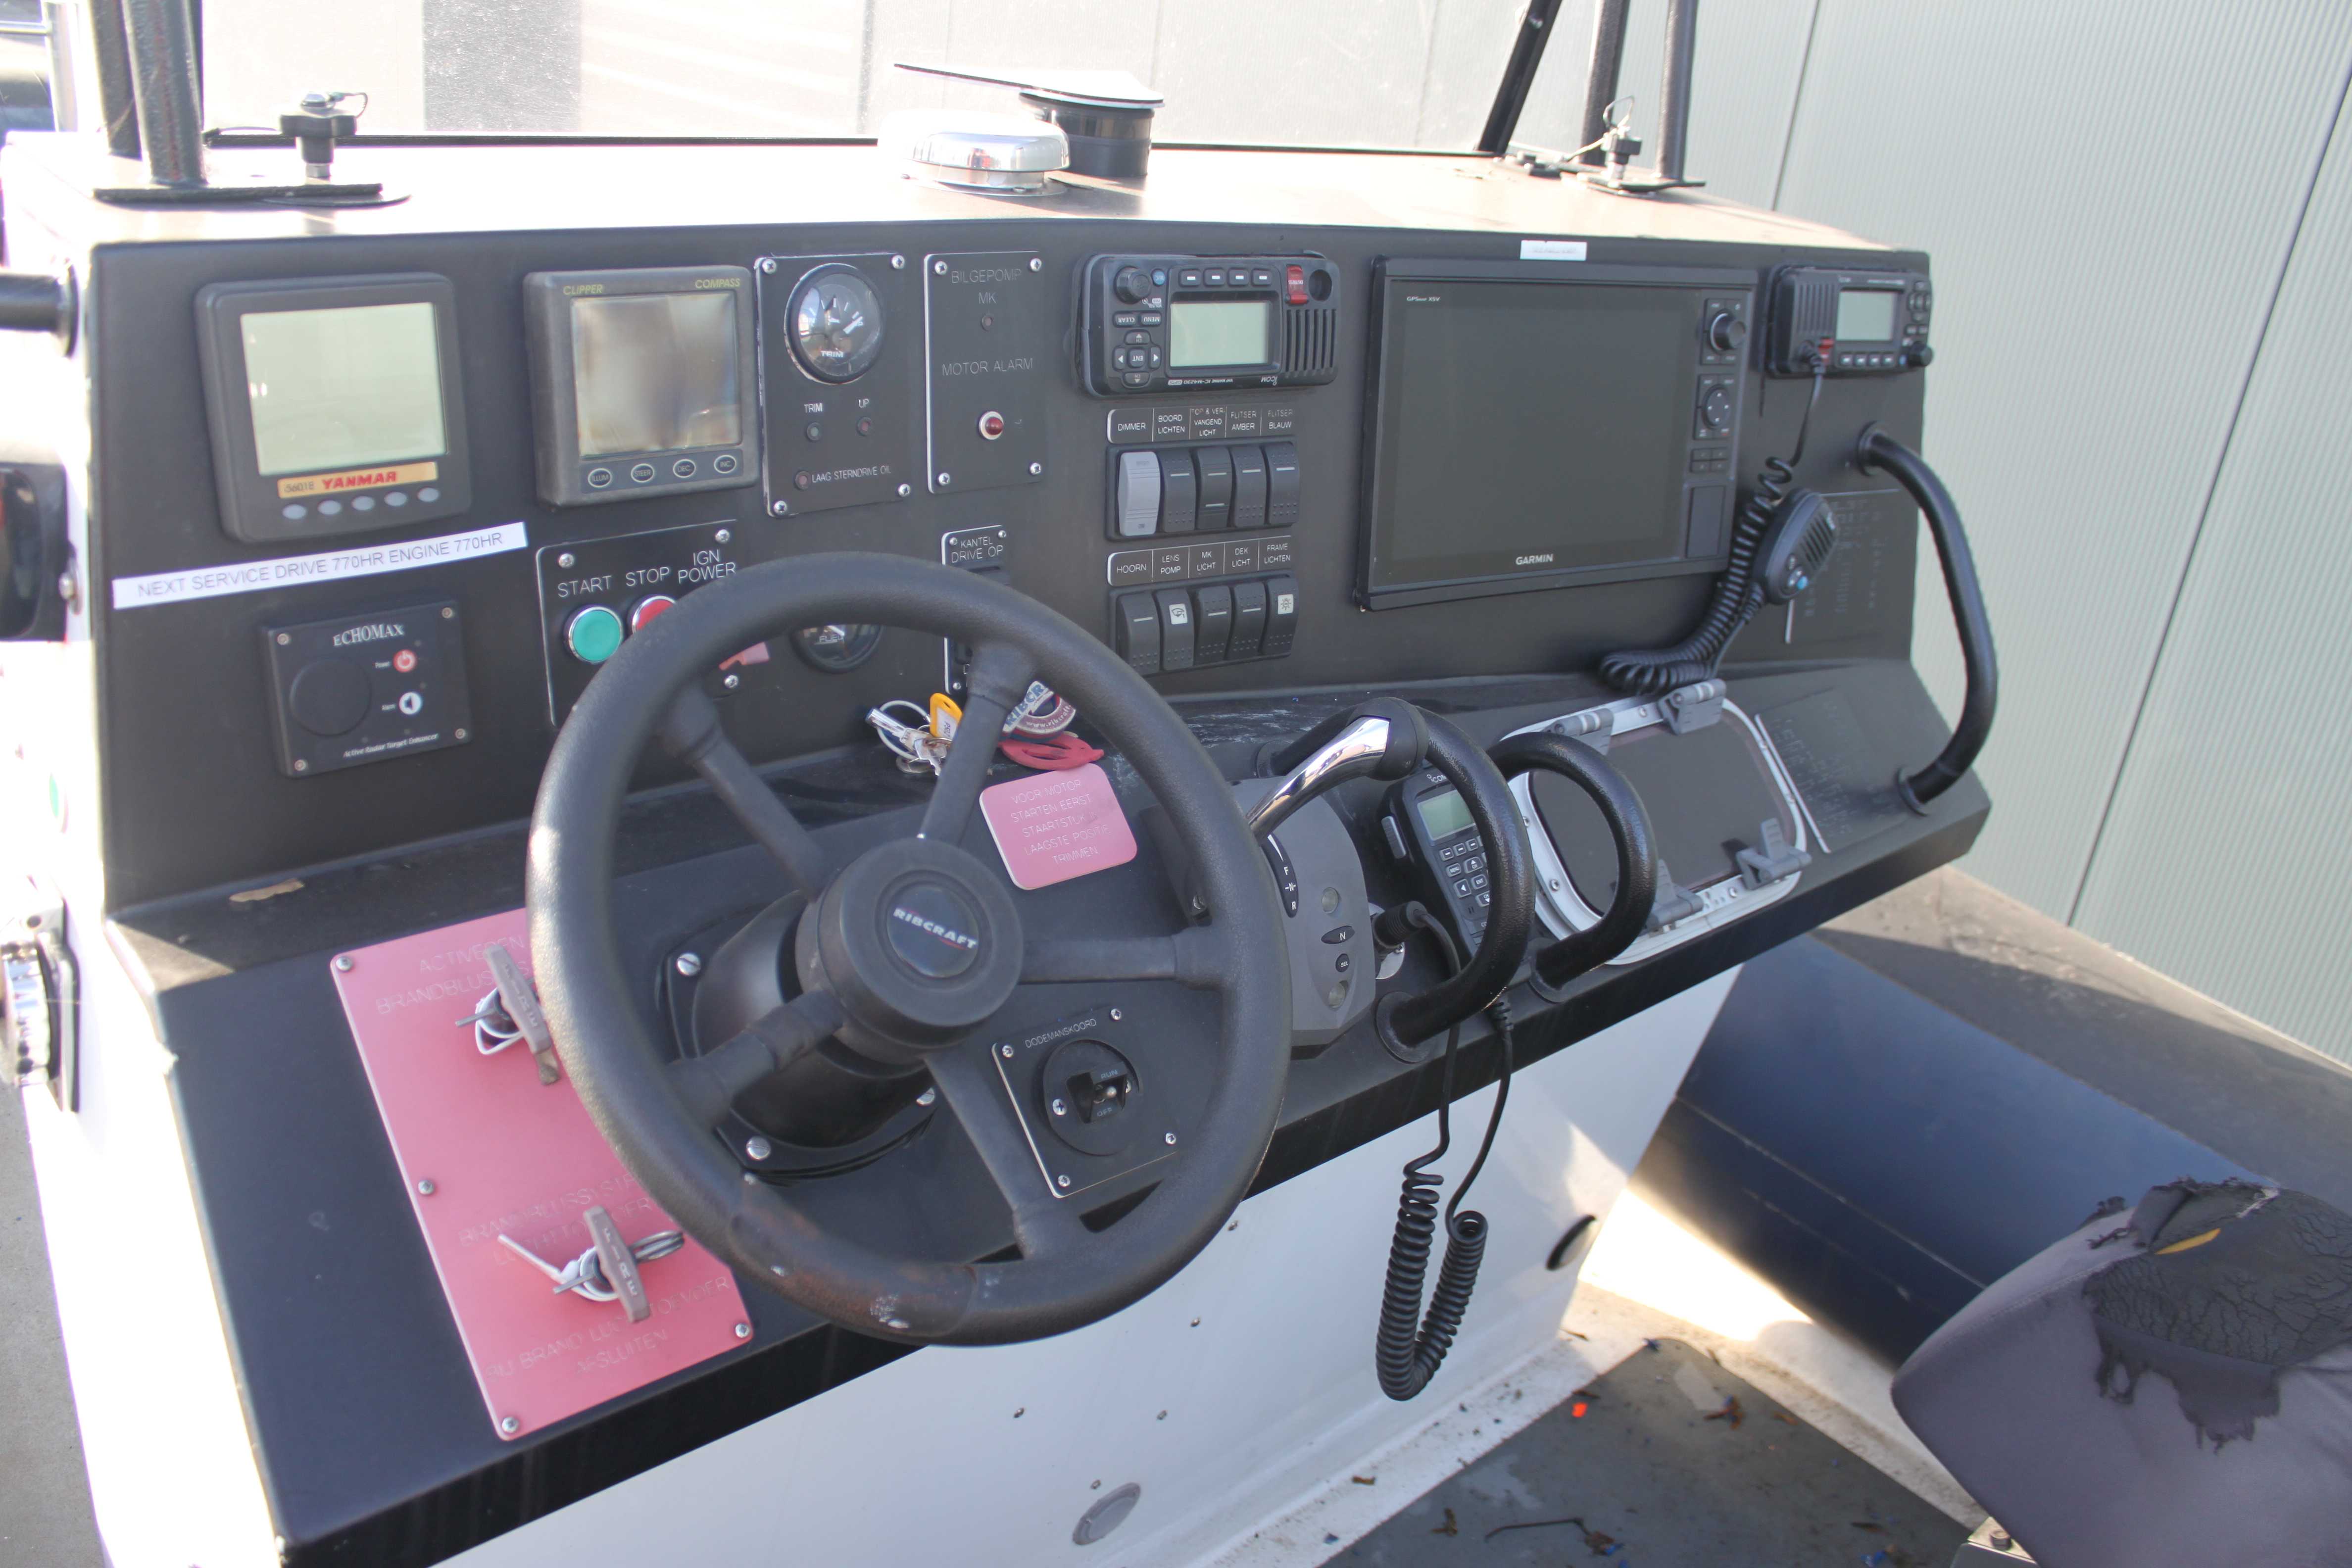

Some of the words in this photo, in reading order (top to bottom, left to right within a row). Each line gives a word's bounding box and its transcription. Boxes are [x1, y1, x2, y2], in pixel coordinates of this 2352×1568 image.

[951, 268, 1023, 284] BILGEPOMP
[695, 278, 740, 289] COMPASS
[563, 284, 604, 295] CLIPPER
[978, 292, 997, 304] MK
[942, 361, 989, 377] MOTOR
[993, 357, 1034, 373] ALARM
[804, 403, 823, 413] TRIM
[859, 399, 870, 408] UP
[1230, 410, 1257, 419] FLITSER
[1268, 408, 1293, 417] FLITSER
[1158, 414, 1183, 423] BOORD
[1194, 418, 1222, 426] VANGEND
[1118, 422, 1146, 432] DIMMER
[1158, 426, 1185, 435] LICHTEN
[1231, 422, 1255, 431] AMBER
[1269, 421, 1291, 430] BLAUW
[634, 469, 651, 477] STEER
[812, 472, 832, 483] LAAG
[834, 467, 878, 480] STERNDRIVE
[880, 464, 891, 475] OIL
[960, 536, 993, 549] KANTEL
[1267, 543, 1288, 552] FRAME
[951, 547, 983, 563] DRIVE
[988, 544, 1004, 557] OP
[1202, 550, 1212, 559] MK
[1234, 547, 1248, 556] DEK
[693, 549, 720, 566] IGN
[1162, 554, 1180, 563] LENS
[1231, 558, 1250, 567] LICHT
[1264, 554, 1291, 564] LICHTEN
[1516, 554, 1553, 565] GARMIN
[138, 578, 186, 597] NEXT
[192, 567, 269, 591] SERVICE
[275, 559, 327, 579] DRIVE
[332, 552, 384, 571] 770HR
[389, 541, 450, 564] ENGINE
[453, 532, 503, 552] 770HR
[1116, 563, 1147, 574] HOORN
[1196, 561, 1216, 571] LICHT
[678, 562, 736, 585] POWER
[1160, 566, 1181, 575] POMP
[626, 567, 670, 587] STOP
[558, 575, 613, 597] START
[333, 624, 404, 646] ECHOMAX
[819, 635, 844, 643] FUEL
[343, 748, 364, 758] Active
[365, 744, 385, 753] Radar
[387, 739, 407, 750] Target
[409, 733, 440, 745] Enhancer
[1011, 789, 1042, 804] VOOR
[1044, 780, 1081, 796] MOTOR
[1011, 804, 1058, 823] STARTEN
[1059, 794, 1091, 810] EERST
[1022, 815, 1085, 837] STAARTSTUK
[1024, 835, 1071, 855] LAAGSTE
[1073, 825, 1111, 841] POSITIE
[1053, 846, 1099, 864] TRIMMEN
[1284, 866, 1288, 875] F
[1292, 901, 1296, 910] R
[893, 908, 978, 949] RIBCRAFT
[1339, 931, 1346, 940] N
[1025, 1018, 1097, 1048] DODEMANSKOORD
[1100, 1069, 1118, 1079] RUN
[1096, 1107, 1113, 1117] OFF
